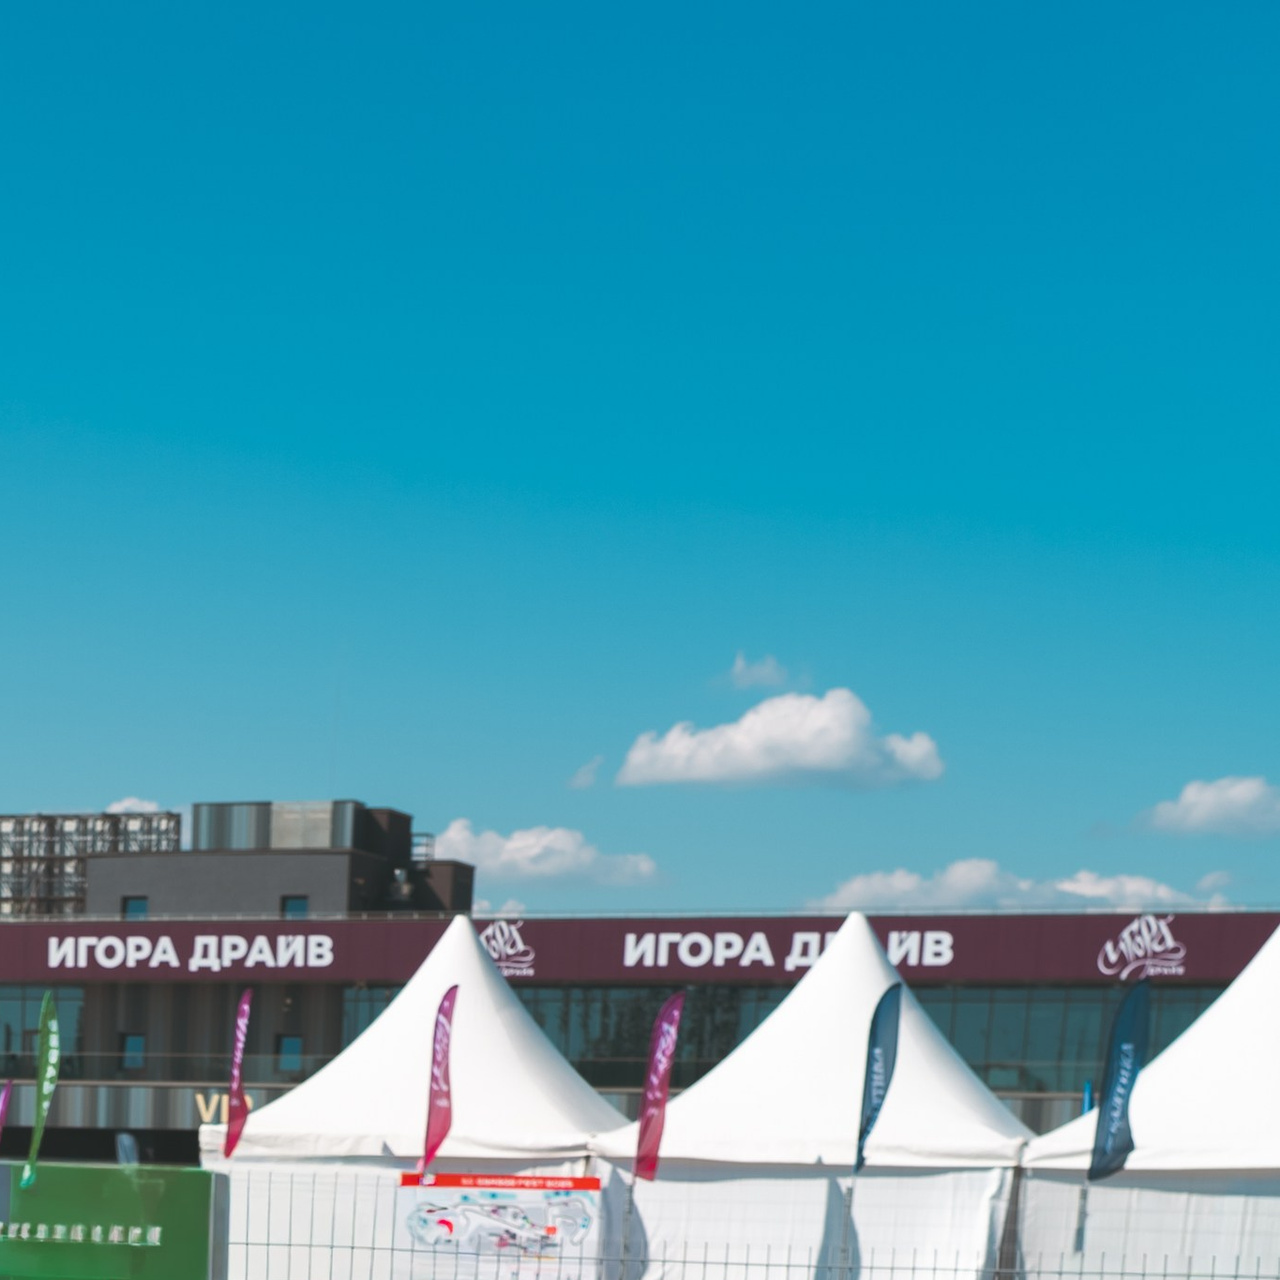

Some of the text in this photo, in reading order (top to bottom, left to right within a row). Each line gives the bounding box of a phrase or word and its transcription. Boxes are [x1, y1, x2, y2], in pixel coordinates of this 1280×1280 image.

[47, 934, 335, 972] ИГОРА ДРАЙВ
[623, 930, 955, 972] ИГОРА ДЙВ
[195, 1093, 254, 1123] VI
